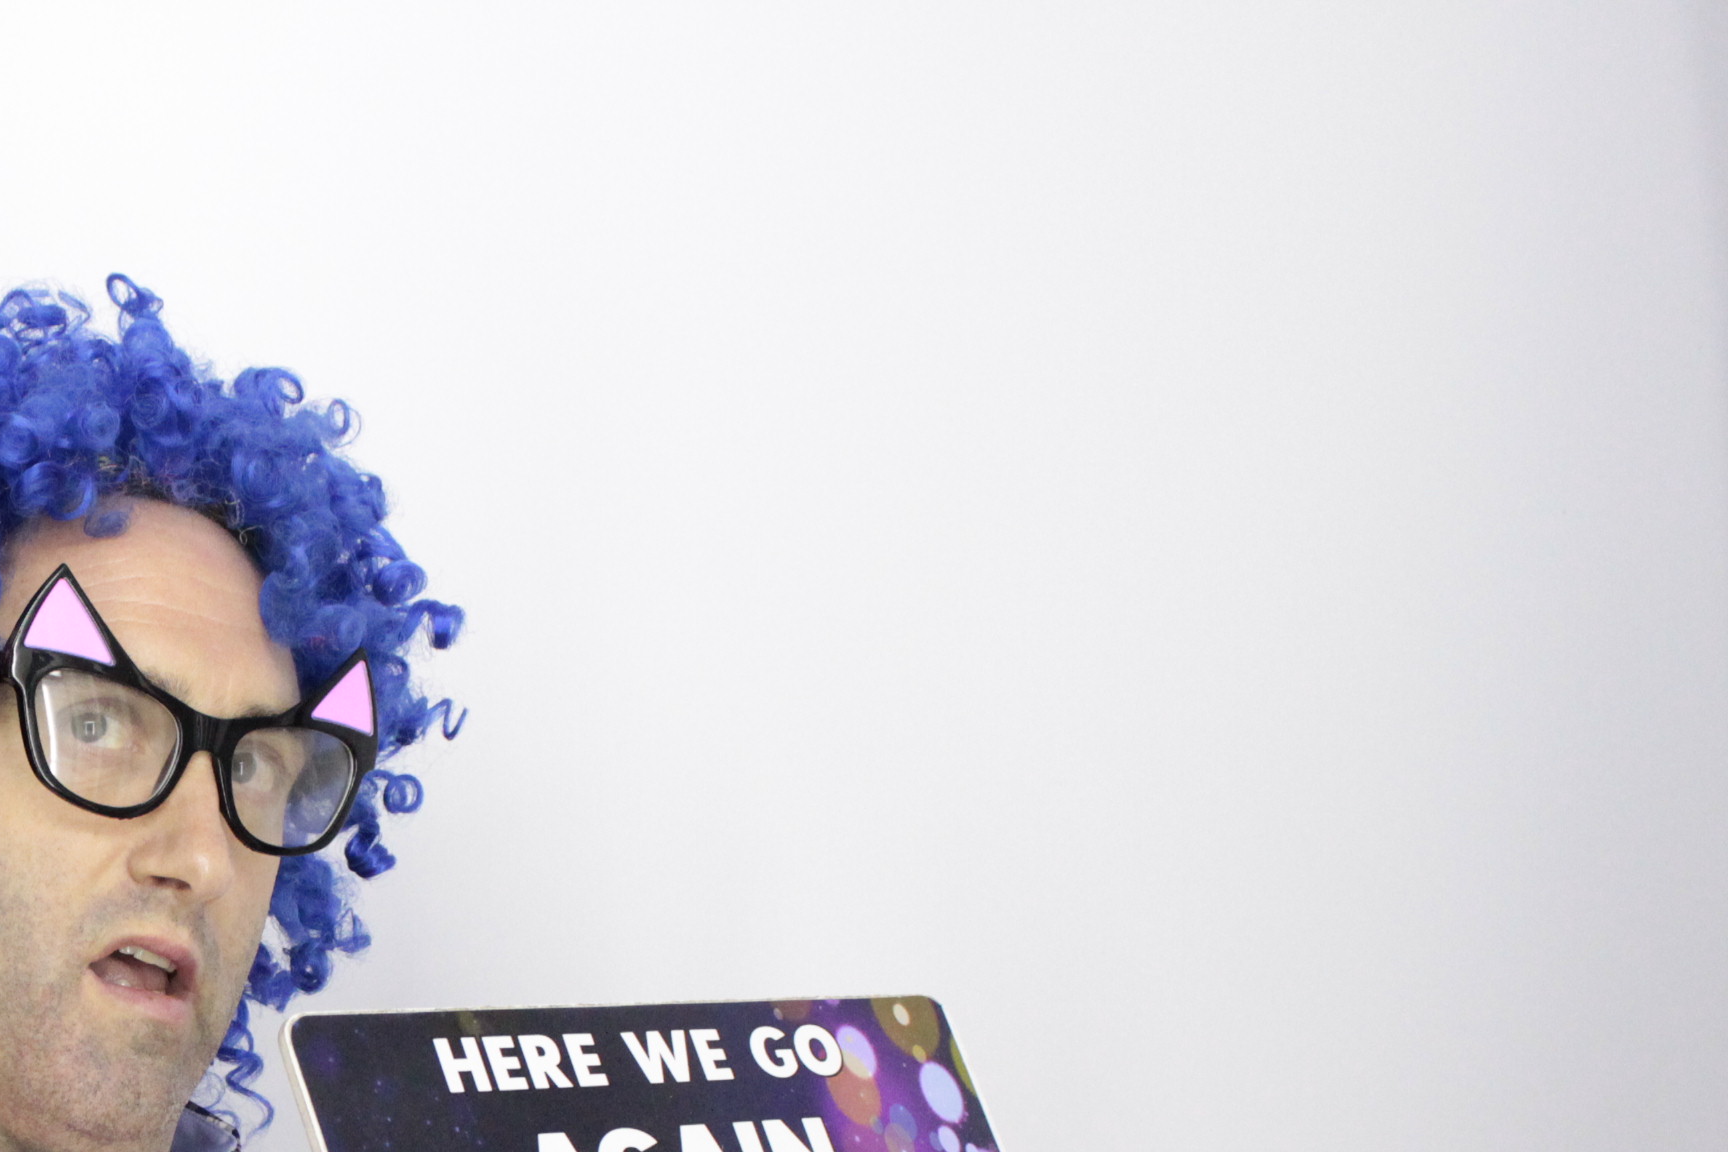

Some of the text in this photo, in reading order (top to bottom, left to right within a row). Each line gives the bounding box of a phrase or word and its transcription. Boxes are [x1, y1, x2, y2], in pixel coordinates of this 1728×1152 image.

[433, 1023, 844, 1094] HERE WE GO
